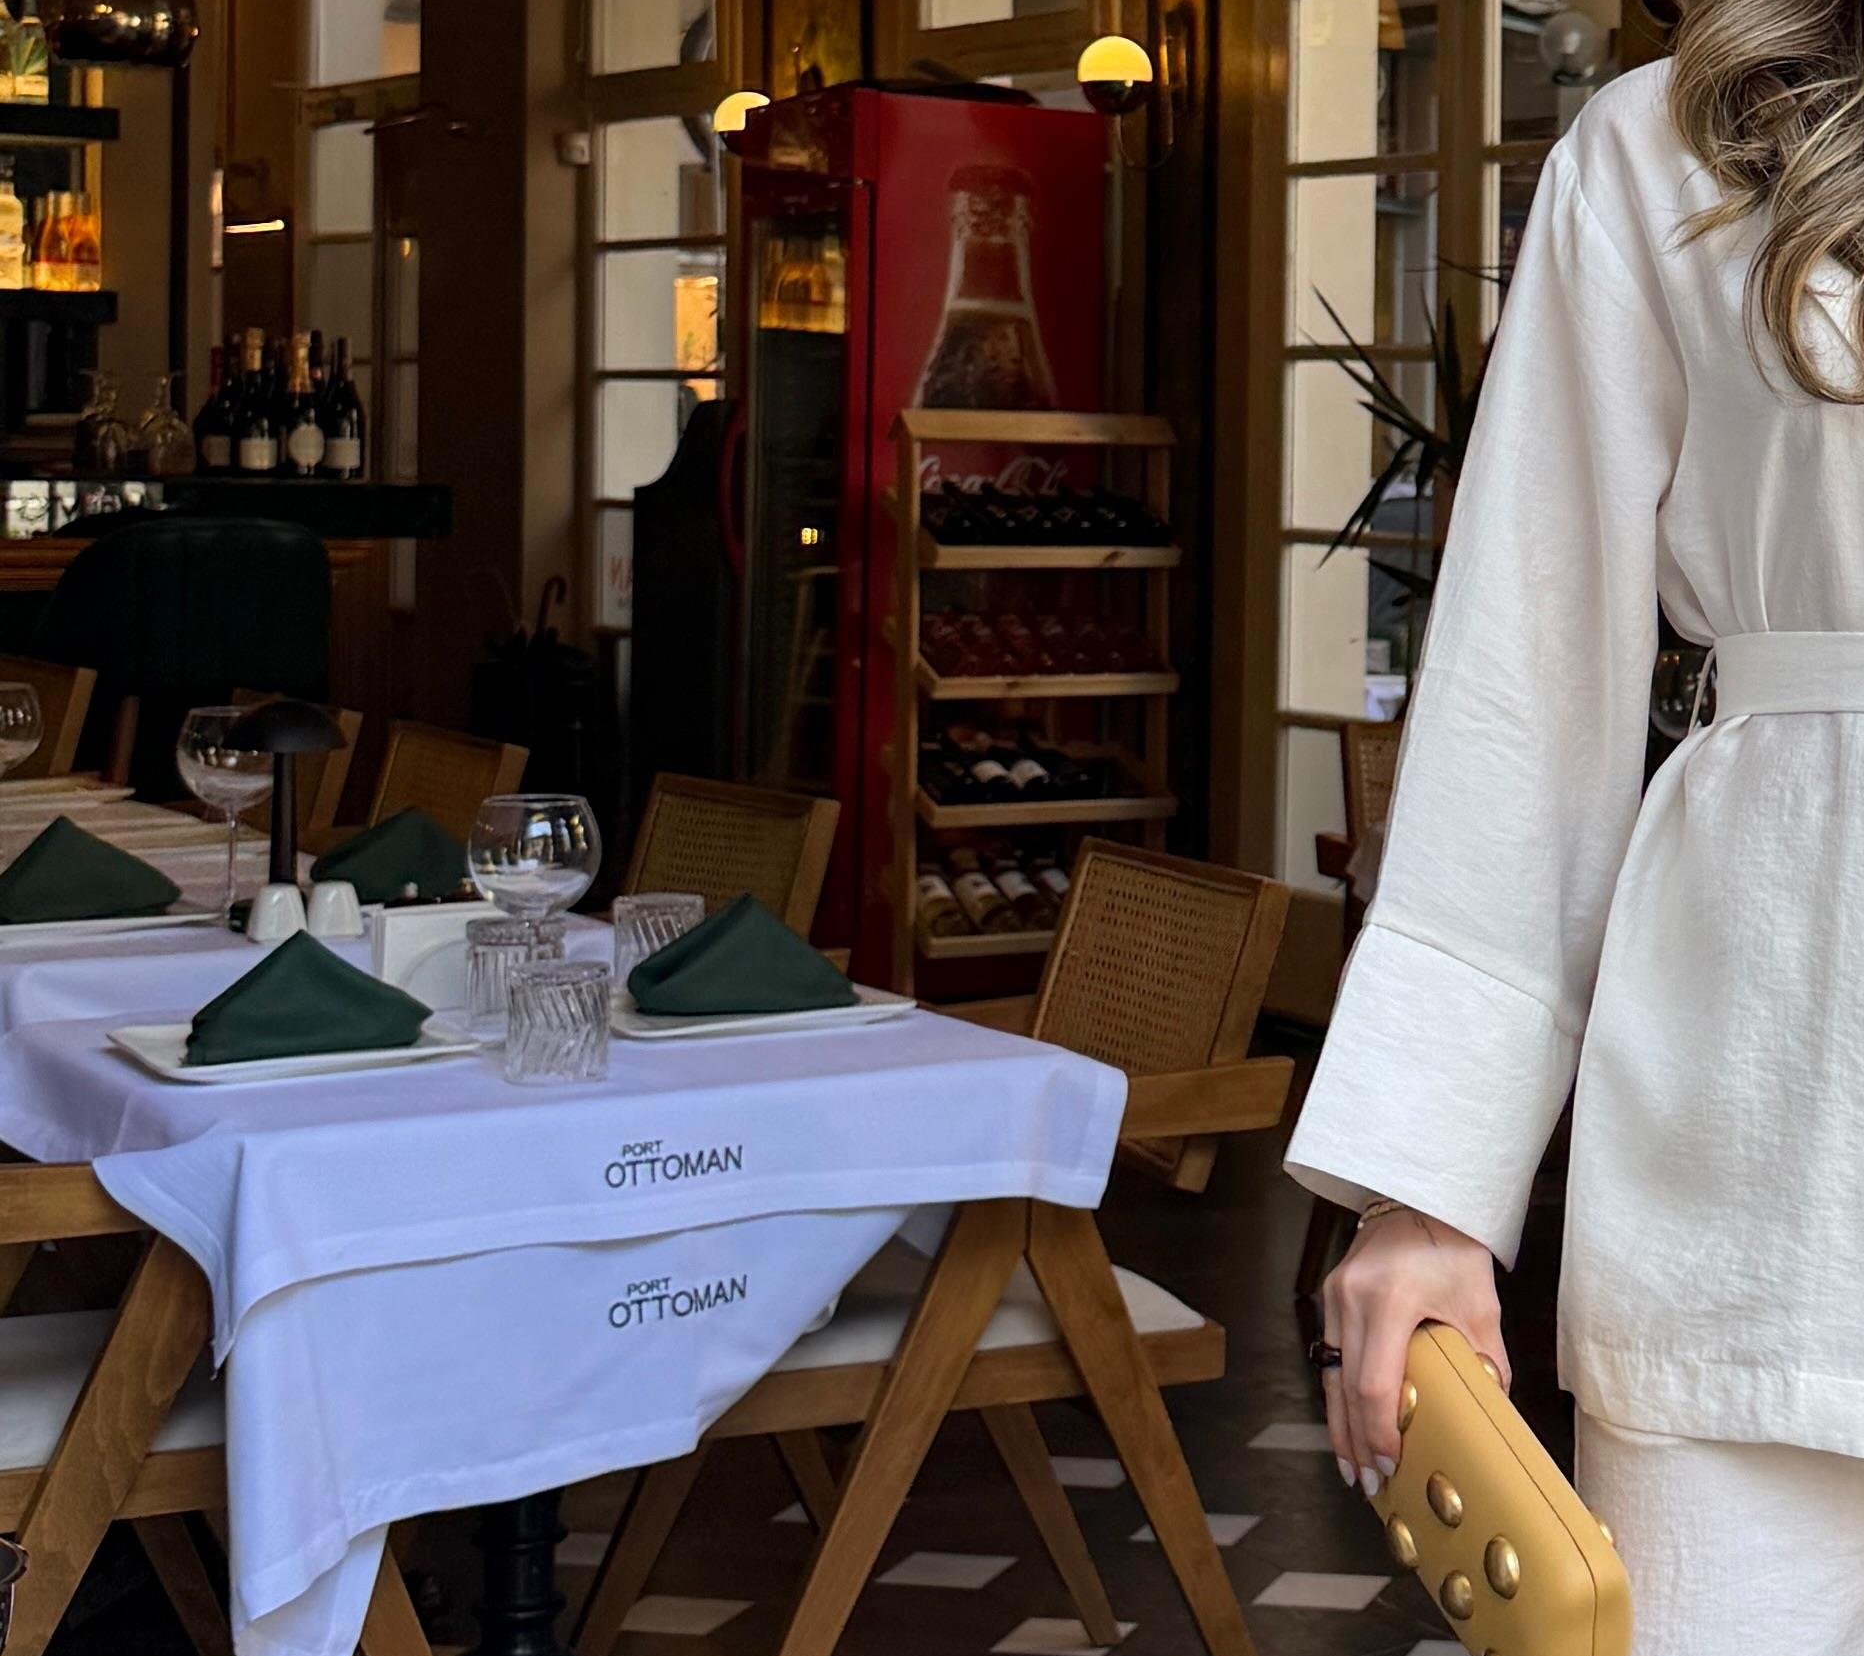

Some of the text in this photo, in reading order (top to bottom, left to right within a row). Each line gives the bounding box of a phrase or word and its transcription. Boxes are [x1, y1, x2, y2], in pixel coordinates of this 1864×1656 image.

[622, 1140, 663, 1158] PORT
[604, 1145, 743, 1189] OTTOMAN
[608, 1274, 748, 1328] OTTOMAN
[627, 1277, 672, 1298] PORT
